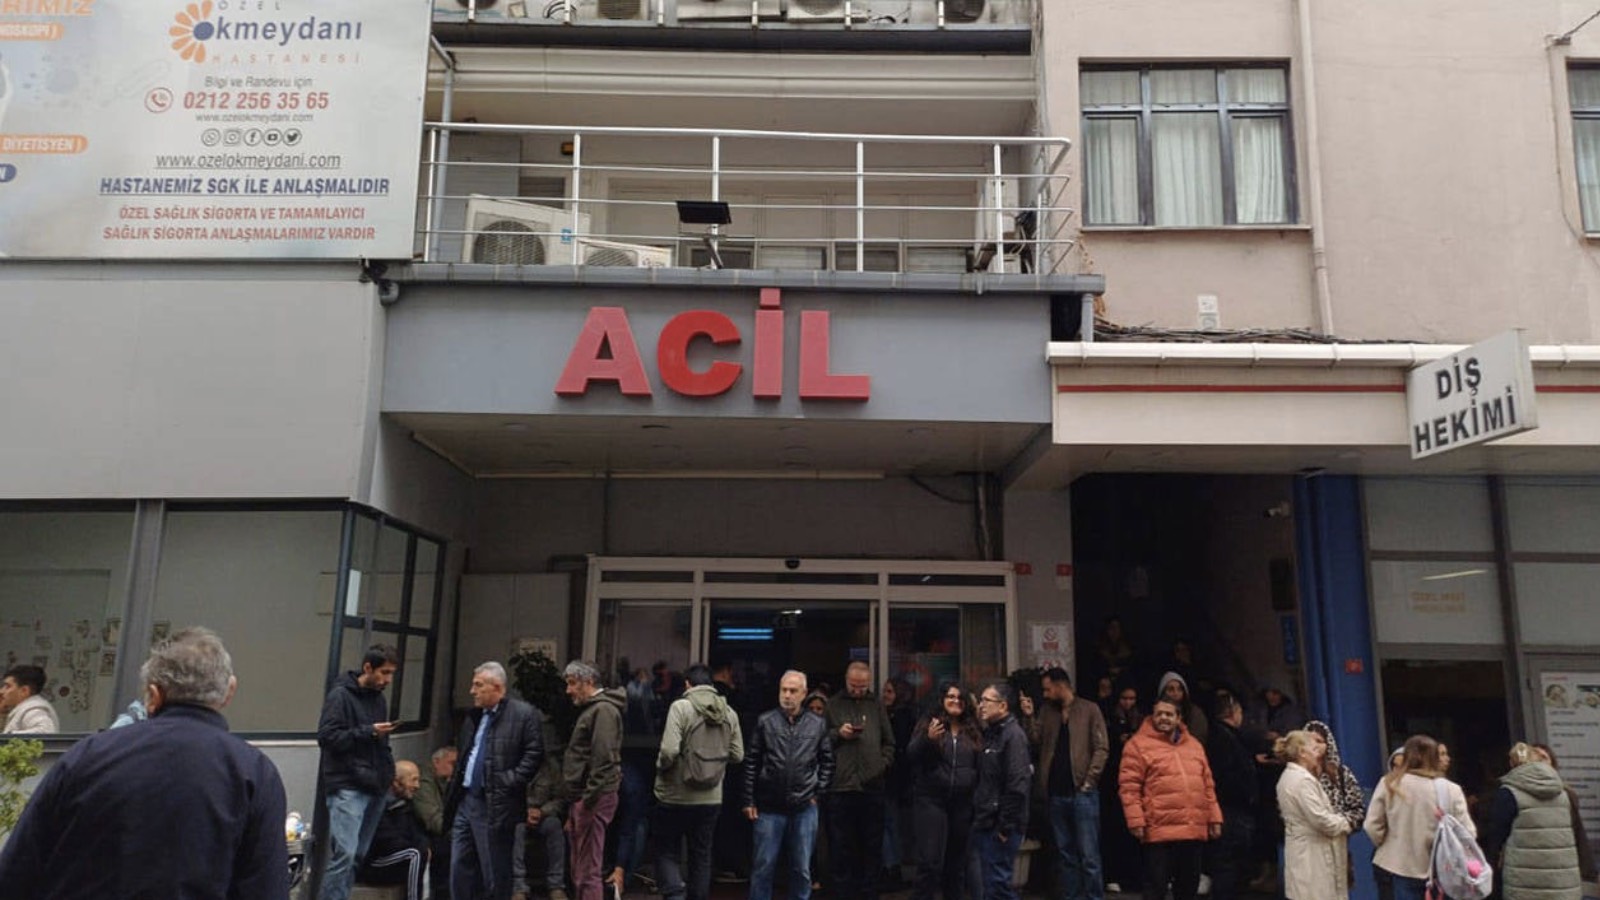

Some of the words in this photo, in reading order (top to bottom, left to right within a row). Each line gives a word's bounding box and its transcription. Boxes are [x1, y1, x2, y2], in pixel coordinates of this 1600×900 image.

[204, 76, 228, 89] Bilgi
[230, 79, 243, 88] ve
[245, 76, 292, 88] Randevu
[183, 91, 231, 110] 0212
[236, 91, 271, 110] 256
[277, 91, 300, 110] 35
[306, 91, 329, 110] 65
[155, 153, 341, 170] www.ozelokmeydani.com
[99, 174, 202, 194] HASTANEMİZ
[206, 178, 240, 194] SGK
[244, 174, 269, 194] İLE
[272, 178, 390, 197] ANLAŞMALIDIR
[119, 204, 151, 220] ÖZEL
[153, 205, 200, 220] SAĞLIK
[202, 204, 257, 220] SİGORTA
[260, 207, 276, 220] VE
[278, 207, 366, 220] TAMAMLAYICI
[102, 225, 150, 240] SAĞLIK
[153, 226, 208, 240] SİGORTA
[210, 227, 326, 243] ANLAŞMALARIMIZ
[328, 227, 376, 240] VARDIR
[554, 288, 871, 401] ACİL
[1435, 356, 1482, 400] DİŞ
[1413, 385, 1517, 454] HEKİMİ
